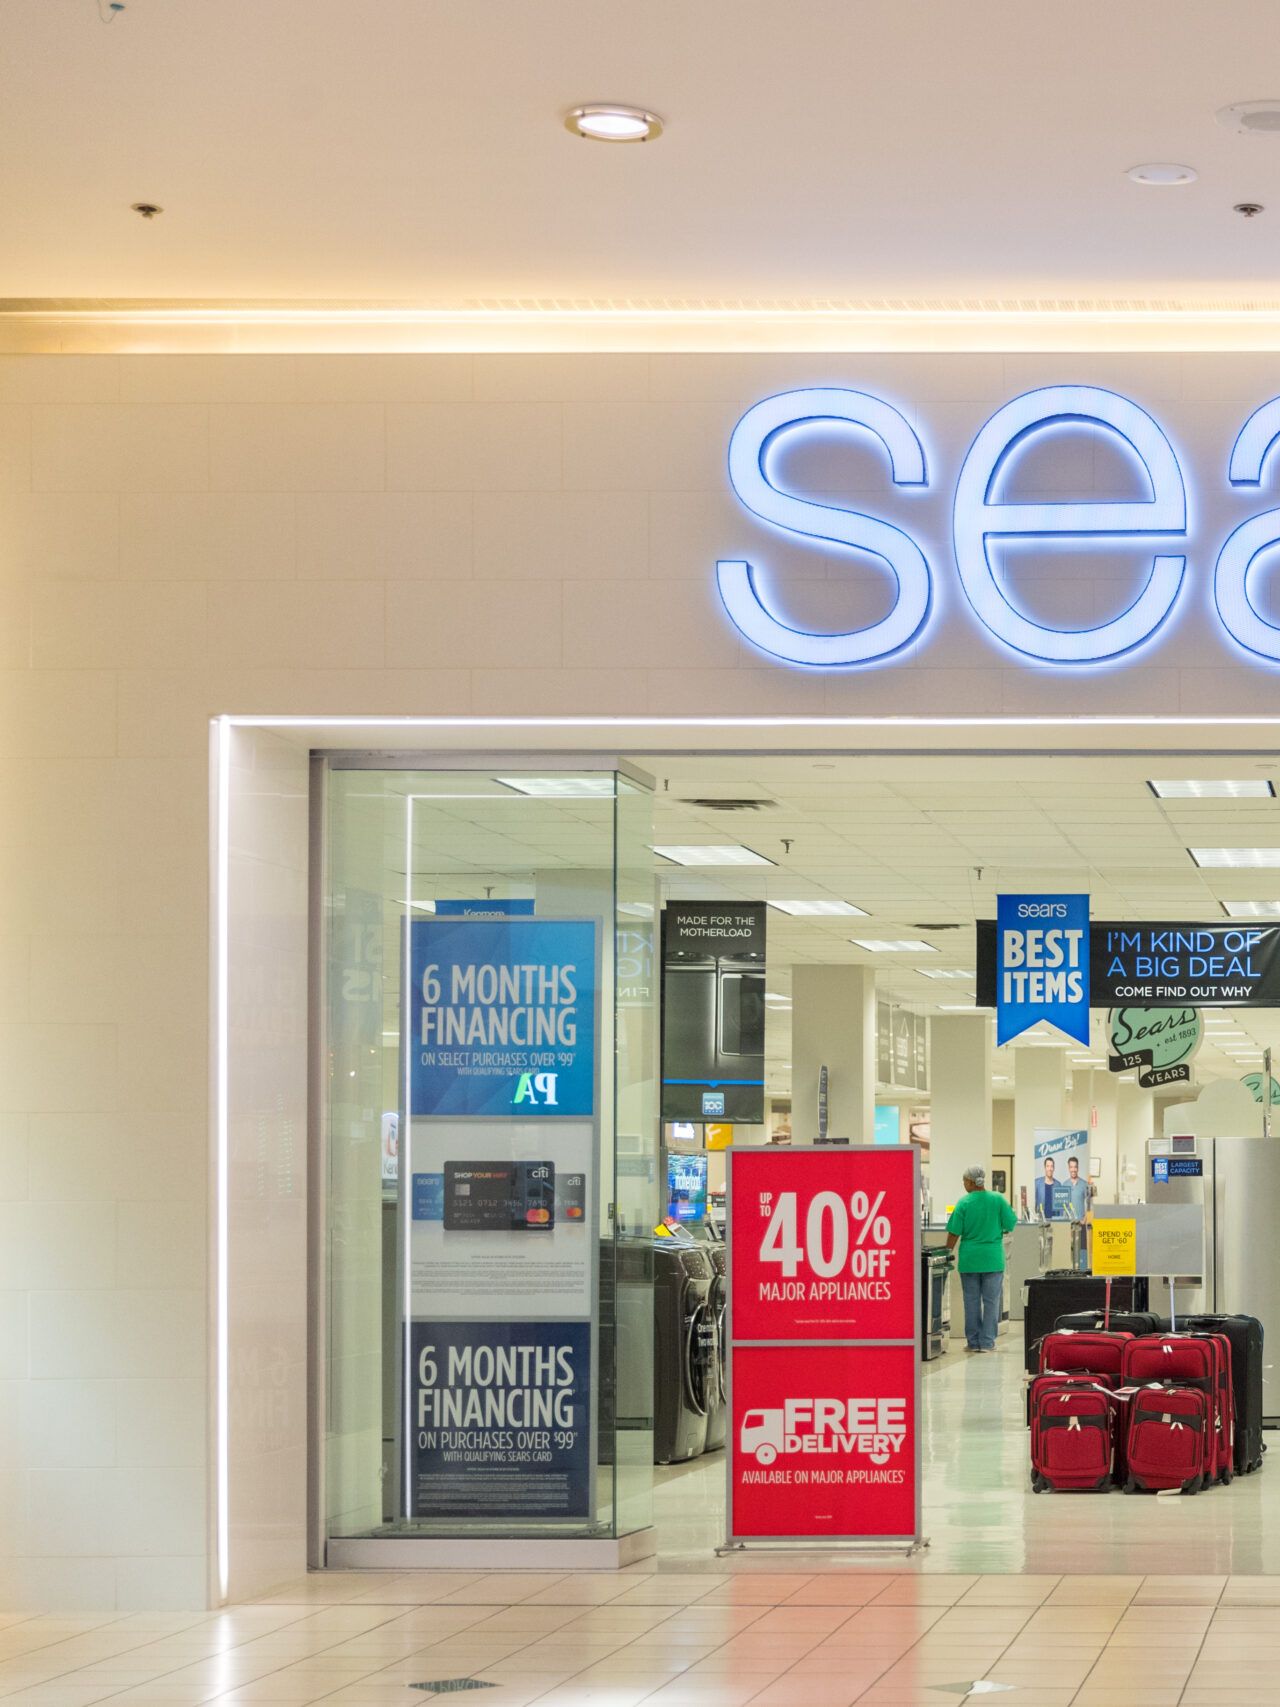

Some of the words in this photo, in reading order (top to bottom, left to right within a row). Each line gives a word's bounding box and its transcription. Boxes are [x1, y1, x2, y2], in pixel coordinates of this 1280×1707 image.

[1018, 904, 1067, 918] sears
[677, 916, 707, 926] MADE
[710, 916, 732, 926] FOR
[735, 917, 755, 926] THE
[680, 928, 752, 937] MOTHERLOAD
[1003, 930, 1083, 967] BEST
[1107, 932, 1141, 952] I'M
[1151, 932, 1214, 952] KIND
[1223, 932, 1262, 952] OF
[1107, 957, 1127, 977] A
[1136, 957, 1180, 977] BIG
[1189, 957, 1261, 977] DEAL
[422, 964, 441, 1004] 6
[451, 964, 577, 1004] MONTHS
[1003, 971, 1083, 1004] ITEMS
[1115, 986, 1152, 997] COME
[1156, 986, 1186, 997] FIND
[1191, 986, 1217, 997] OUT
[1220, 986, 1252, 997] WHY
[421, 1007, 577, 1046] FINANCING
[1111, 1008, 1196, 1047] Sears
[1178, 1028, 1196, 1041] 1893
[421, 1052, 435, 1066] ON
[438, 1052, 469, 1066] SELECT
[472, 1052, 527, 1066] PURCHASES
[530, 1052, 555, 1066] OVER
[1123, 1054, 1142, 1067] 125
[1148, 1067, 1186, 1084] YEARS
[531, 1167, 550, 1178] citi
[567, 1177, 581, 1186] citi
[760, 1192, 773, 1204] UP
[760, 1205, 771, 1217] TO
[760, 1282, 805, 1301] MAJOR
[809, 1282, 891, 1300] APPLIANCES
[419, 1345, 438, 1386] 6
[448, 1345, 575, 1387] MONTHS
[785, 1398, 906, 1433] FREE
[418, 1431, 437, 1449] ON
[441, 1431, 513, 1449] PURCHASES
[517, 1431, 550, 1449] OVER
[785, 1434, 906, 1453] DELIVERY
[443, 1451, 463, 1462] WITH
[464, 1451, 506, 1462] QUALIFYING
[508, 1451, 531, 1462] SEARS
[532, 1451, 553, 1462] CARD
[742, 1471, 792, 1484] AVAILABLE
[794, 1471, 808, 1484] ON
[811, 1471, 843, 1484] MAJOR
